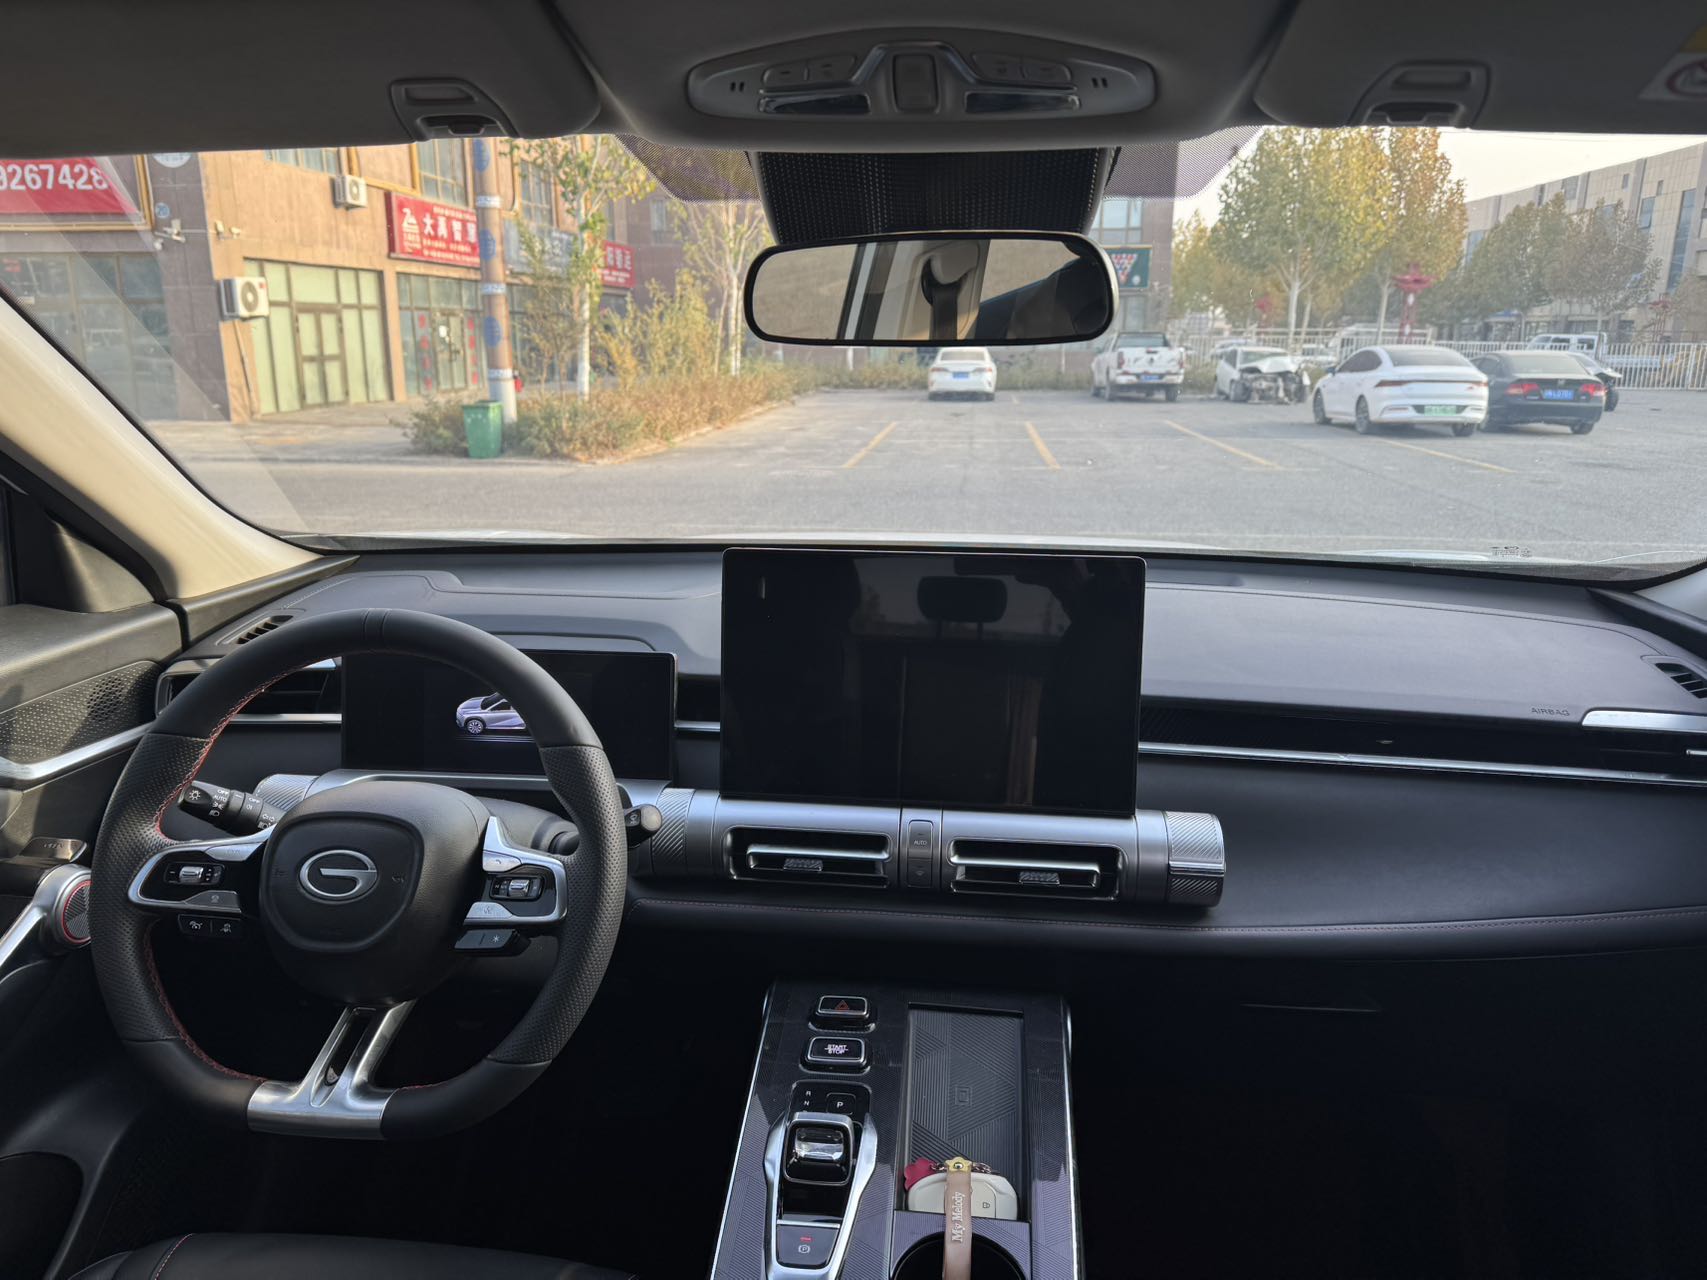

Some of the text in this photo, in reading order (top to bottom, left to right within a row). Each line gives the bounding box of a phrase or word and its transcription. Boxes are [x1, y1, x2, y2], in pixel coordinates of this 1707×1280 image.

[1531, 706, 1570, 717] AIRBAG
[214, 794, 227, 802] AUTO
[951, 1191, 966, 1242] My Melody
